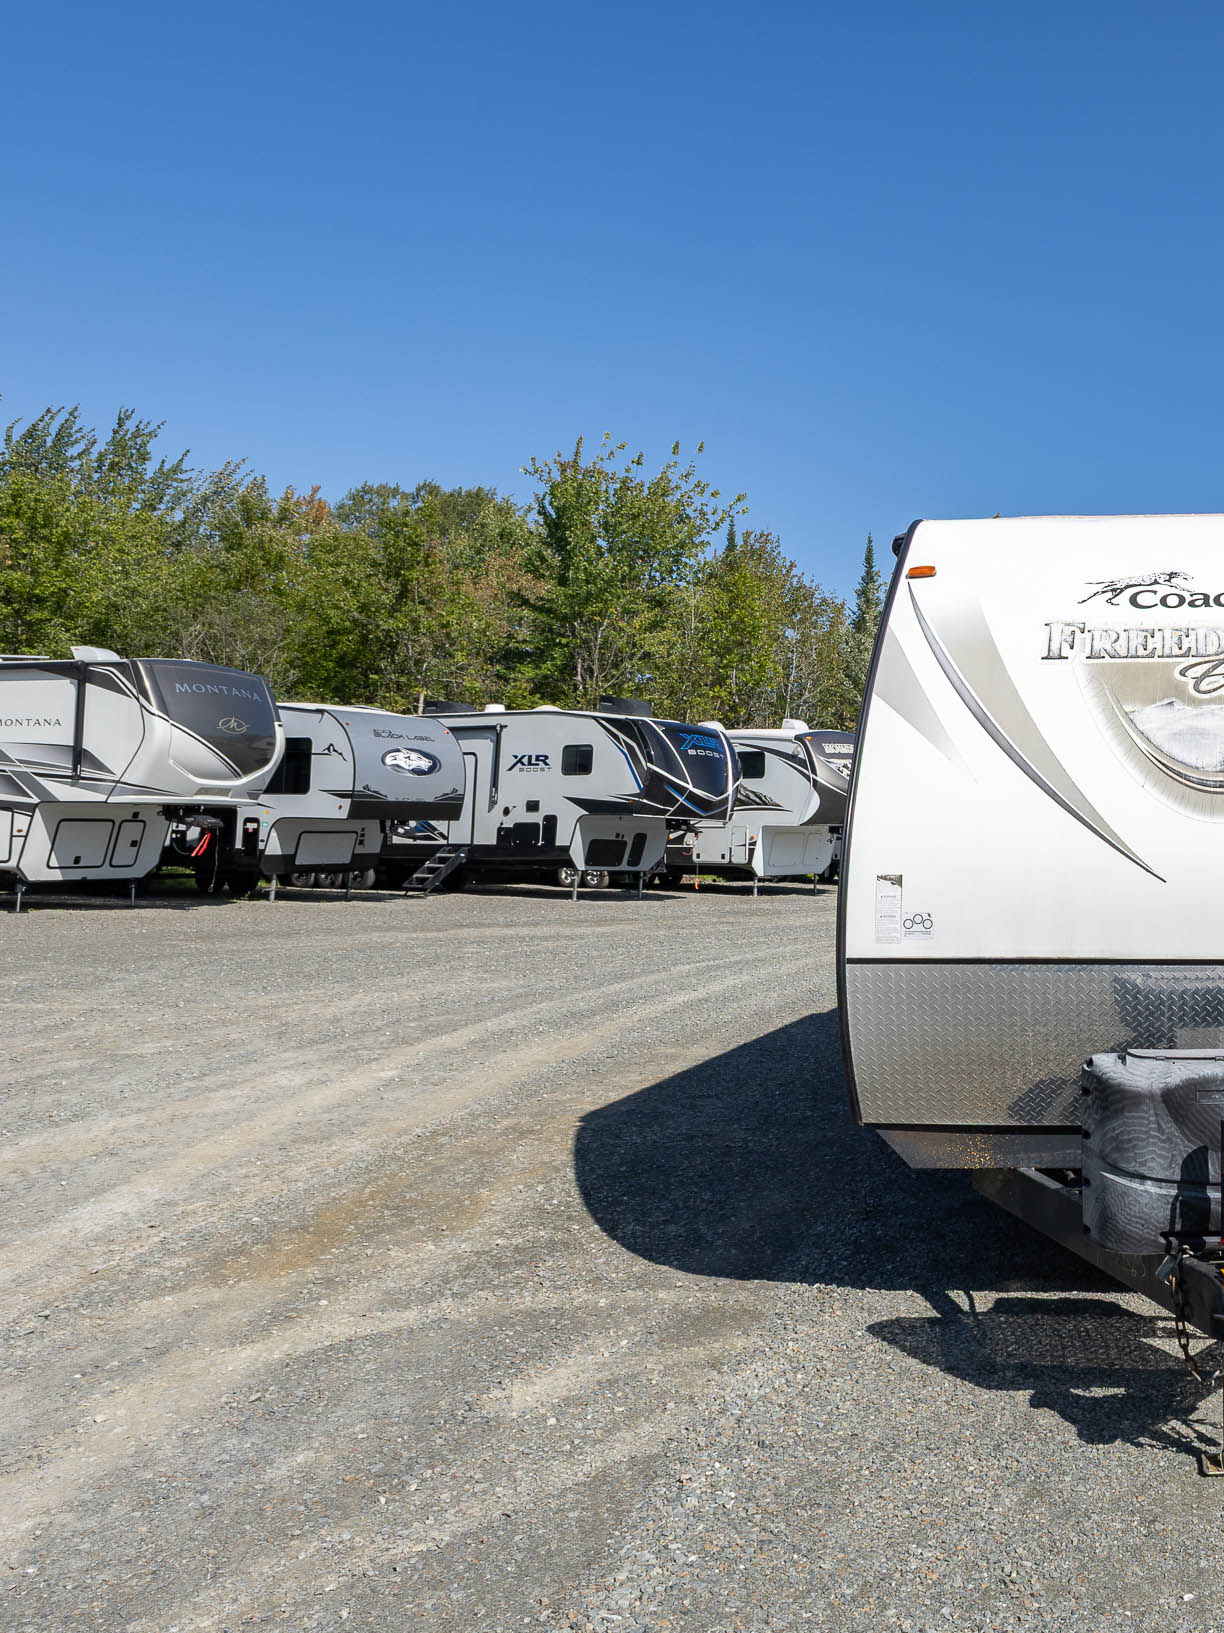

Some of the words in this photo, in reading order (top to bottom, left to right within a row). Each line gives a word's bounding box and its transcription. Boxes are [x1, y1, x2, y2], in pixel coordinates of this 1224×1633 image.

[175, 683, 262, 702] MONTANA
[506, 754, 552, 771] XLR
[687, 749, 725, 760] BOOST
